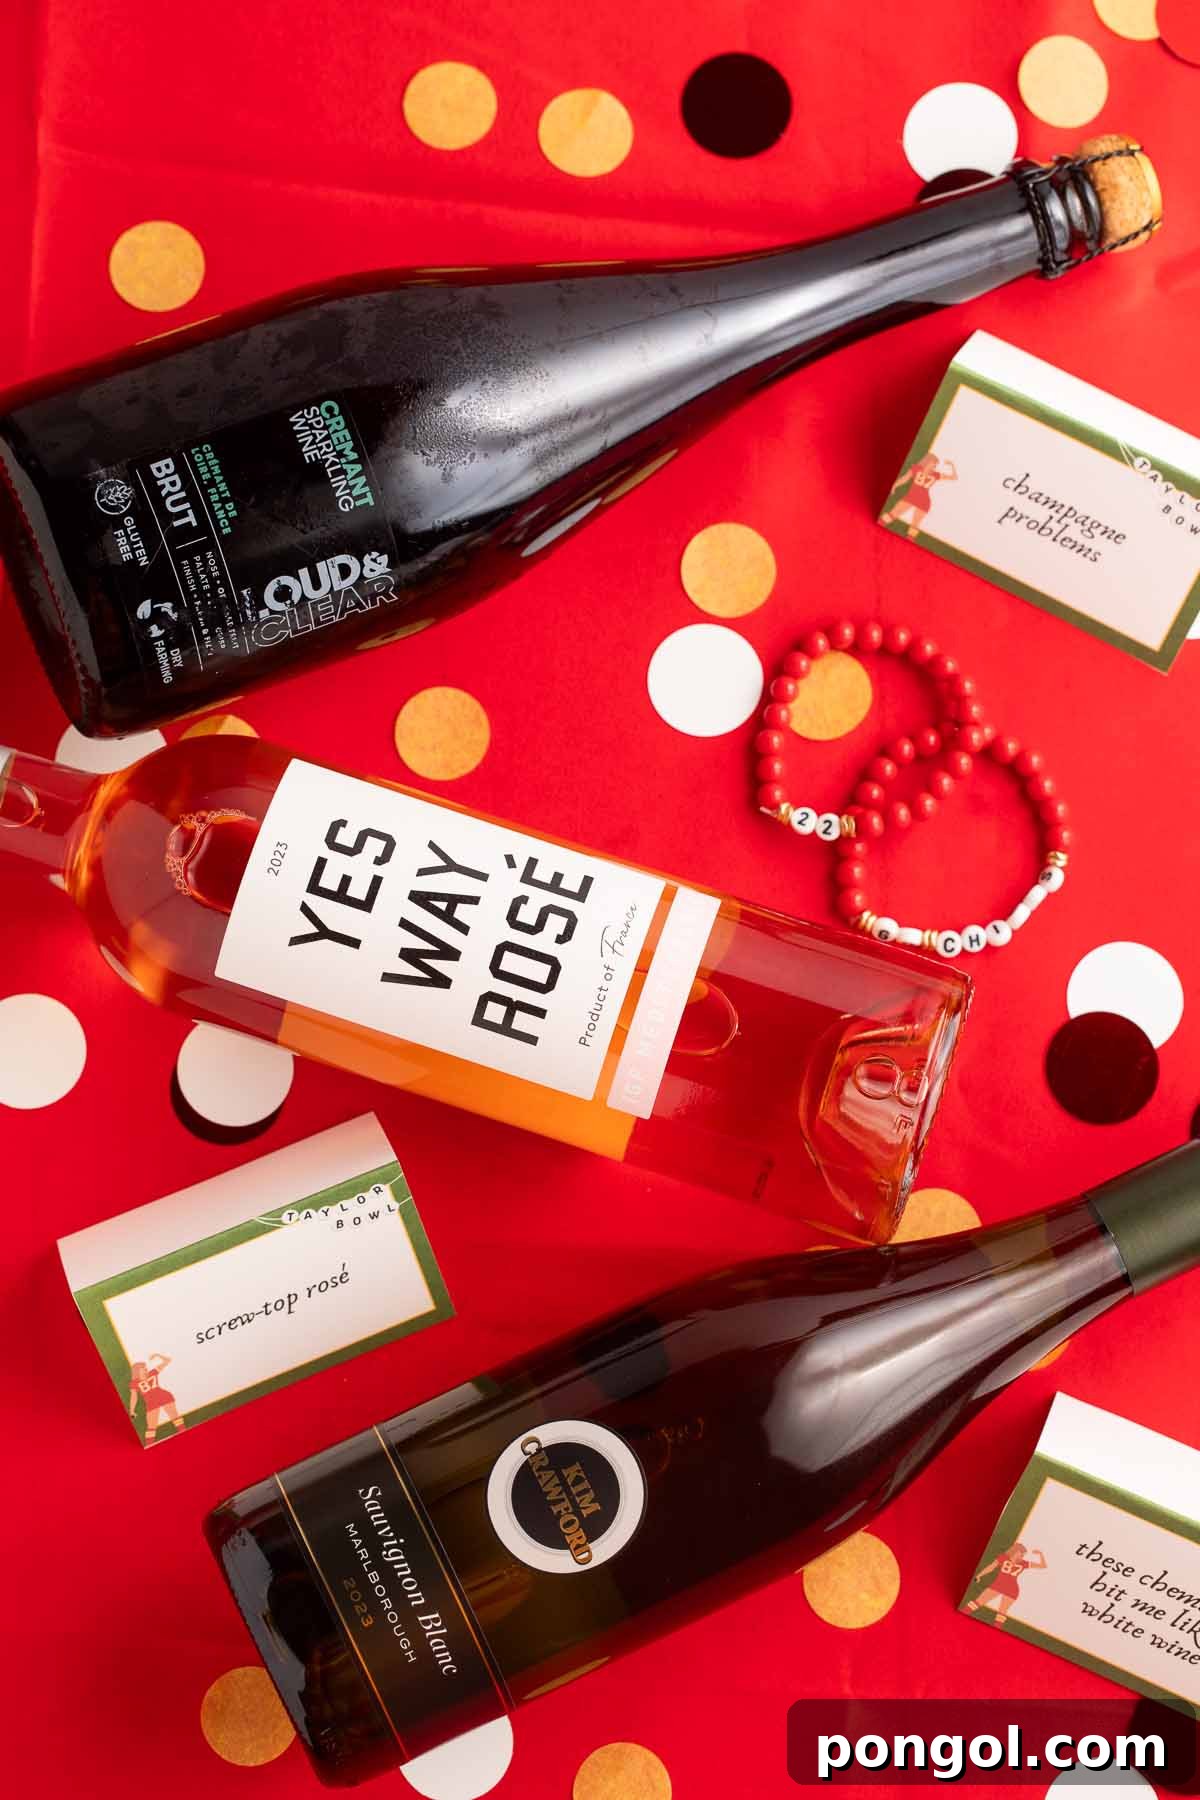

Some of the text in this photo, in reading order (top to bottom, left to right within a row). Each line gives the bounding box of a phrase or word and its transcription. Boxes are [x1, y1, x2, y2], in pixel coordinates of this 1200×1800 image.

[289, 410, 321, 464] WINE
[303, 406, 354, 512] SPARKLING
[149, 457, 198, 528] BRUT
[202, 444, 238, 518] CRÉMANT DE
[913, 469, 938, 489] 87
[207, 488, 232, 535] FRANCE
[997, 505, 1103, 564] problems
[1002, 472, 1127, 546] champagne
[113, 528, 134, 562] FREE
[123, 516, 150, 567] GLUTEN
[205, 551, 220, 577] NOSE
[180, 559, 197, 592] FINISH
[193, 555, 210, 591] PALATE
[251, 575, 399, 647] CLEAR
[153, 640, 173, 684] FARMING
[169, 648, 184, 668] DRY
[797, 811, 834, 836] 22
[267, 841, 289, 877] 2023
[287, 818, 398, 950] YES
[380, 839, 490, 989] WAY
[470, 853, 595, 1046] ROSÉ
[578, 903, 638, 1047] Product of France
[287, 1184, 384, 1222] TAYLOR
[335, 1203, 397, 1229] BOWL
[195, 1262, 351, 1344] screw-top rosé
[138, 1375, 160, 1393] 87
[520, 1436, 593, 1566] CRAWFORD
[560, 1461, 601, 1518] KIM
[345, 1522, 417, 1664] MARLBOROUGH
[358, 1485, 458, 1676] Sauvignon Blanc
[1000, 1560, 1024, 1578] 87
[1075, 1540, 1200, 1612] these chem
[1089, 1570, 1128, 1602] hit
[1130, 1598, 1167, 1620] me
[343, 1577, 375, 1628] 2023
[1081, 1600, 1200, 1665] white wine
